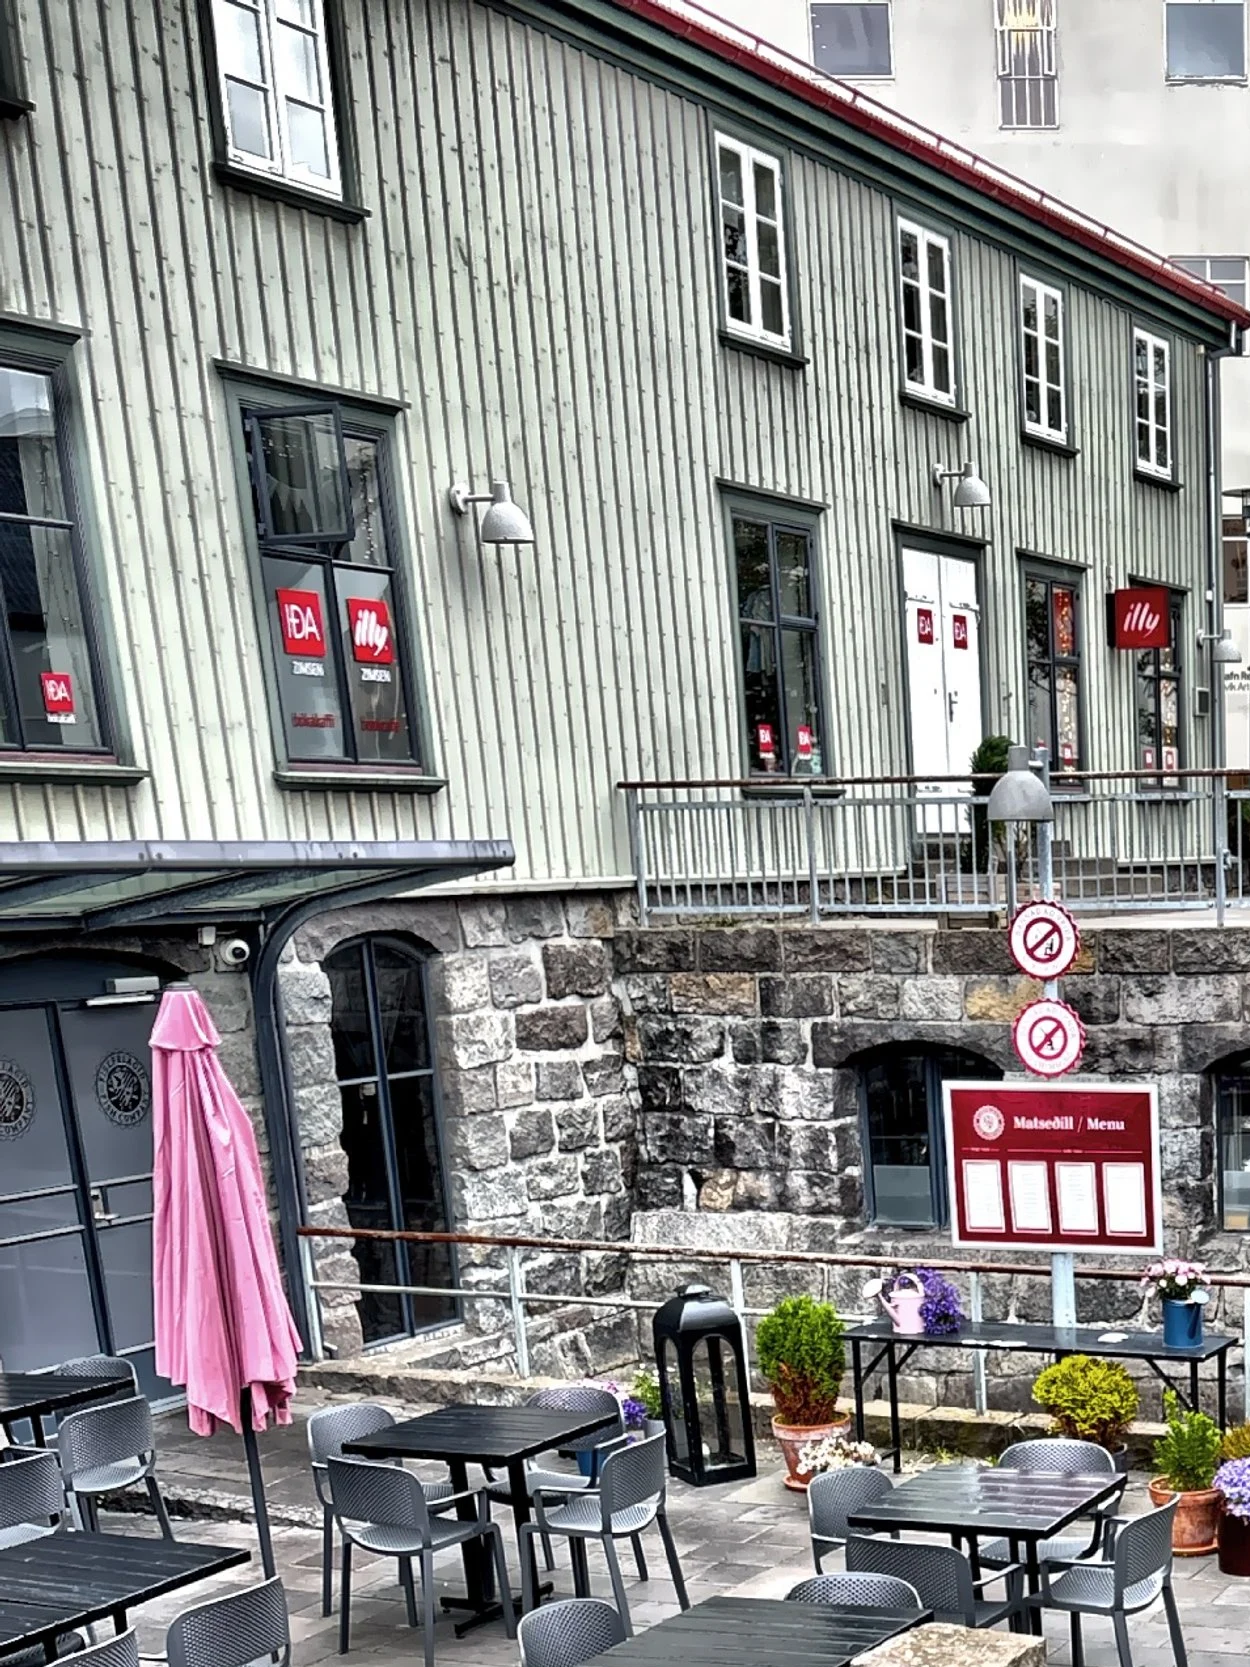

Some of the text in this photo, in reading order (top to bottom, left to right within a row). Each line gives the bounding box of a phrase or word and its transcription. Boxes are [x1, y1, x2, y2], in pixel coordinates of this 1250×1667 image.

[285, 604, 321, 641] IÐA
[355, 609, 388, 656] illy
[1123, 602, 1160, 638] illy
[1013, 1115, 1074, 1131] Matseðill
[1087, 1117, 1125, 1131] Menu
